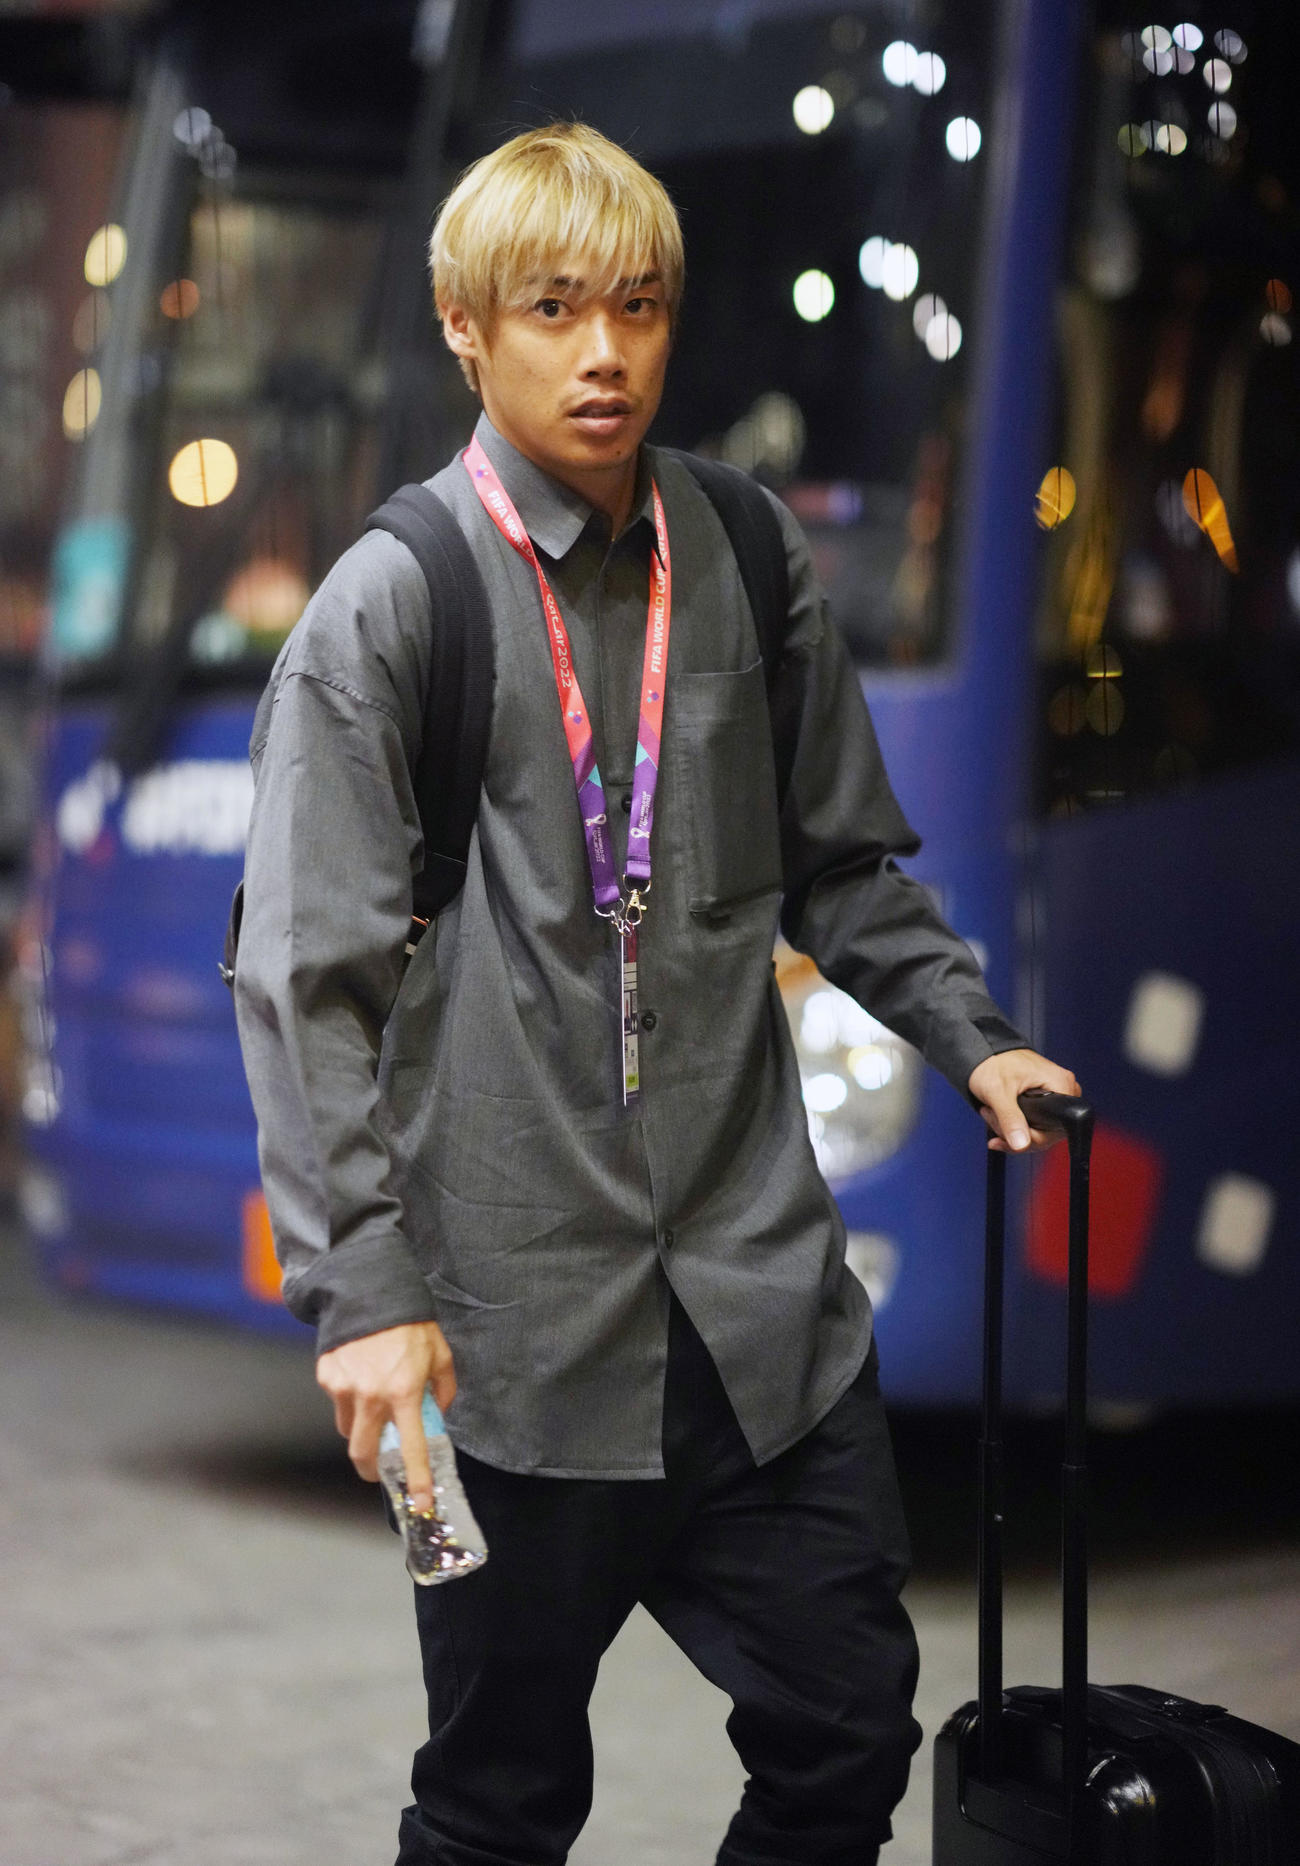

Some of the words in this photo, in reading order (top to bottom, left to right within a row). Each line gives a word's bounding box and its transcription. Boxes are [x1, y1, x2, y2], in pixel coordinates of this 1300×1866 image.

[487, 490, 508, 519] FIFA
[503, 515, 534, 558] WORLD
[656, 567, 667, 594] CUP
[653, 597, 665, 643] WORLD
[651, 644, 662, 673] FIFA
